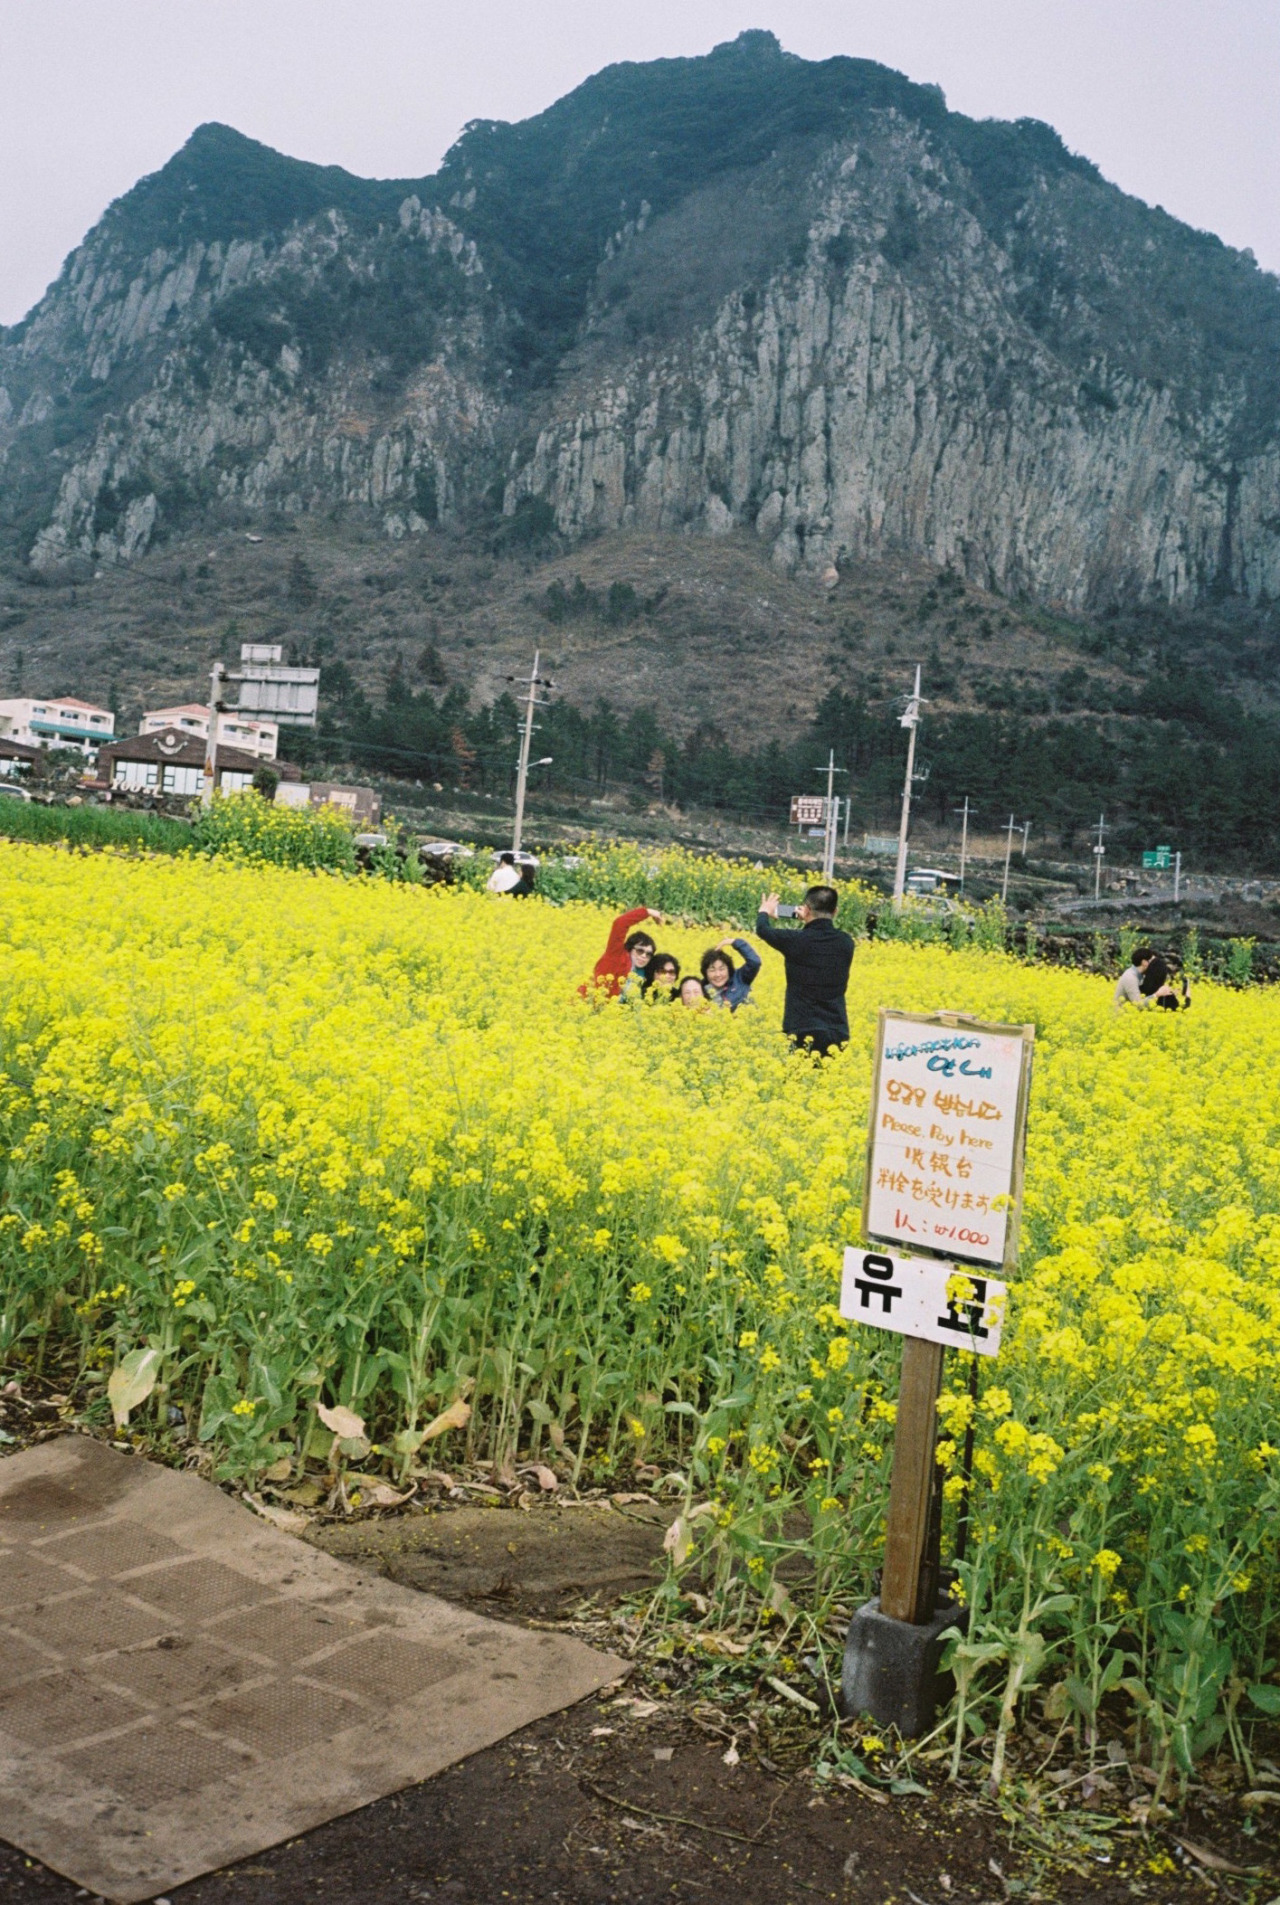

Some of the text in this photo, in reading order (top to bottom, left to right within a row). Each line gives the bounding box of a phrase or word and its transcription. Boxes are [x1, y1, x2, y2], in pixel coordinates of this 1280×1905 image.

[927, 1055, 992, 1079] 안내
[933, 1089, 1003, 1121] 받습니다
[929, 1123, 954, 1147] Pay
[959, 1129, 994, 1150] here
[876, 1167, 991, 1215] 料金を受けます
